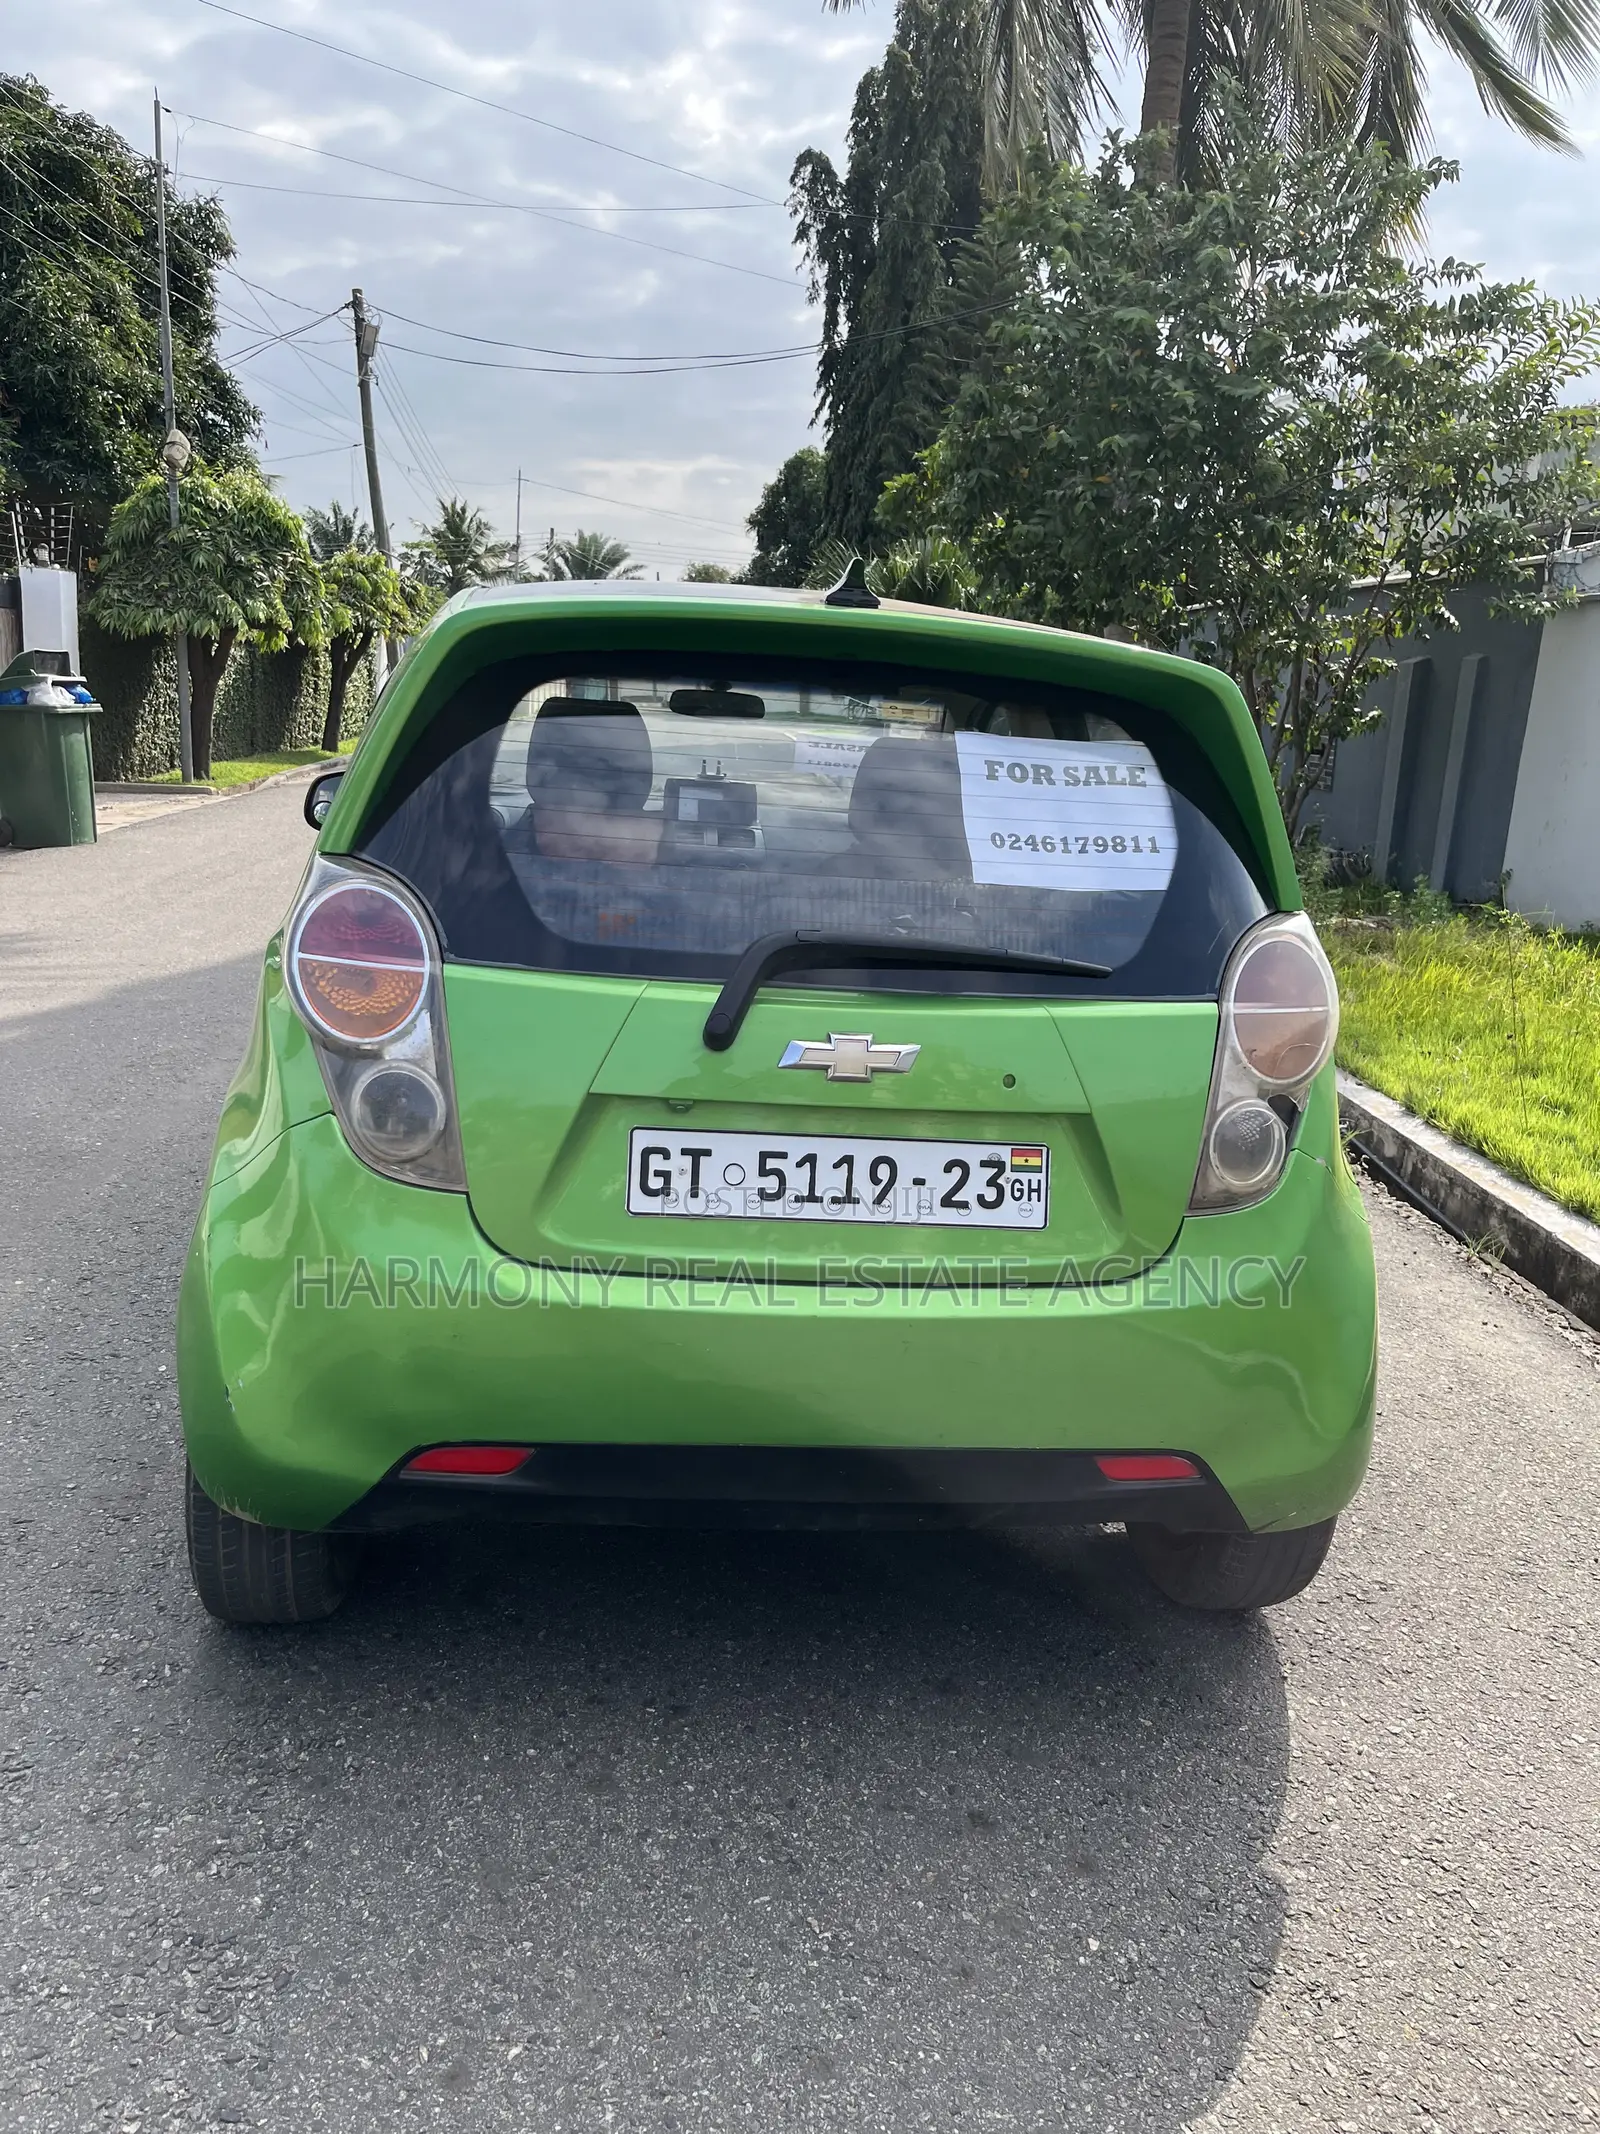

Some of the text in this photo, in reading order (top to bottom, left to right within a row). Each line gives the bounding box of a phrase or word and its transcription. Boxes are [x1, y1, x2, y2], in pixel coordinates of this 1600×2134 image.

[984, 760, 1146, 787] FOR SALE
[990, 832, 1160, 854] 0246179811
[640, 1146, 1006, 1209] GT 5119-23
[1010, 1178, 1042, 1202] GH
